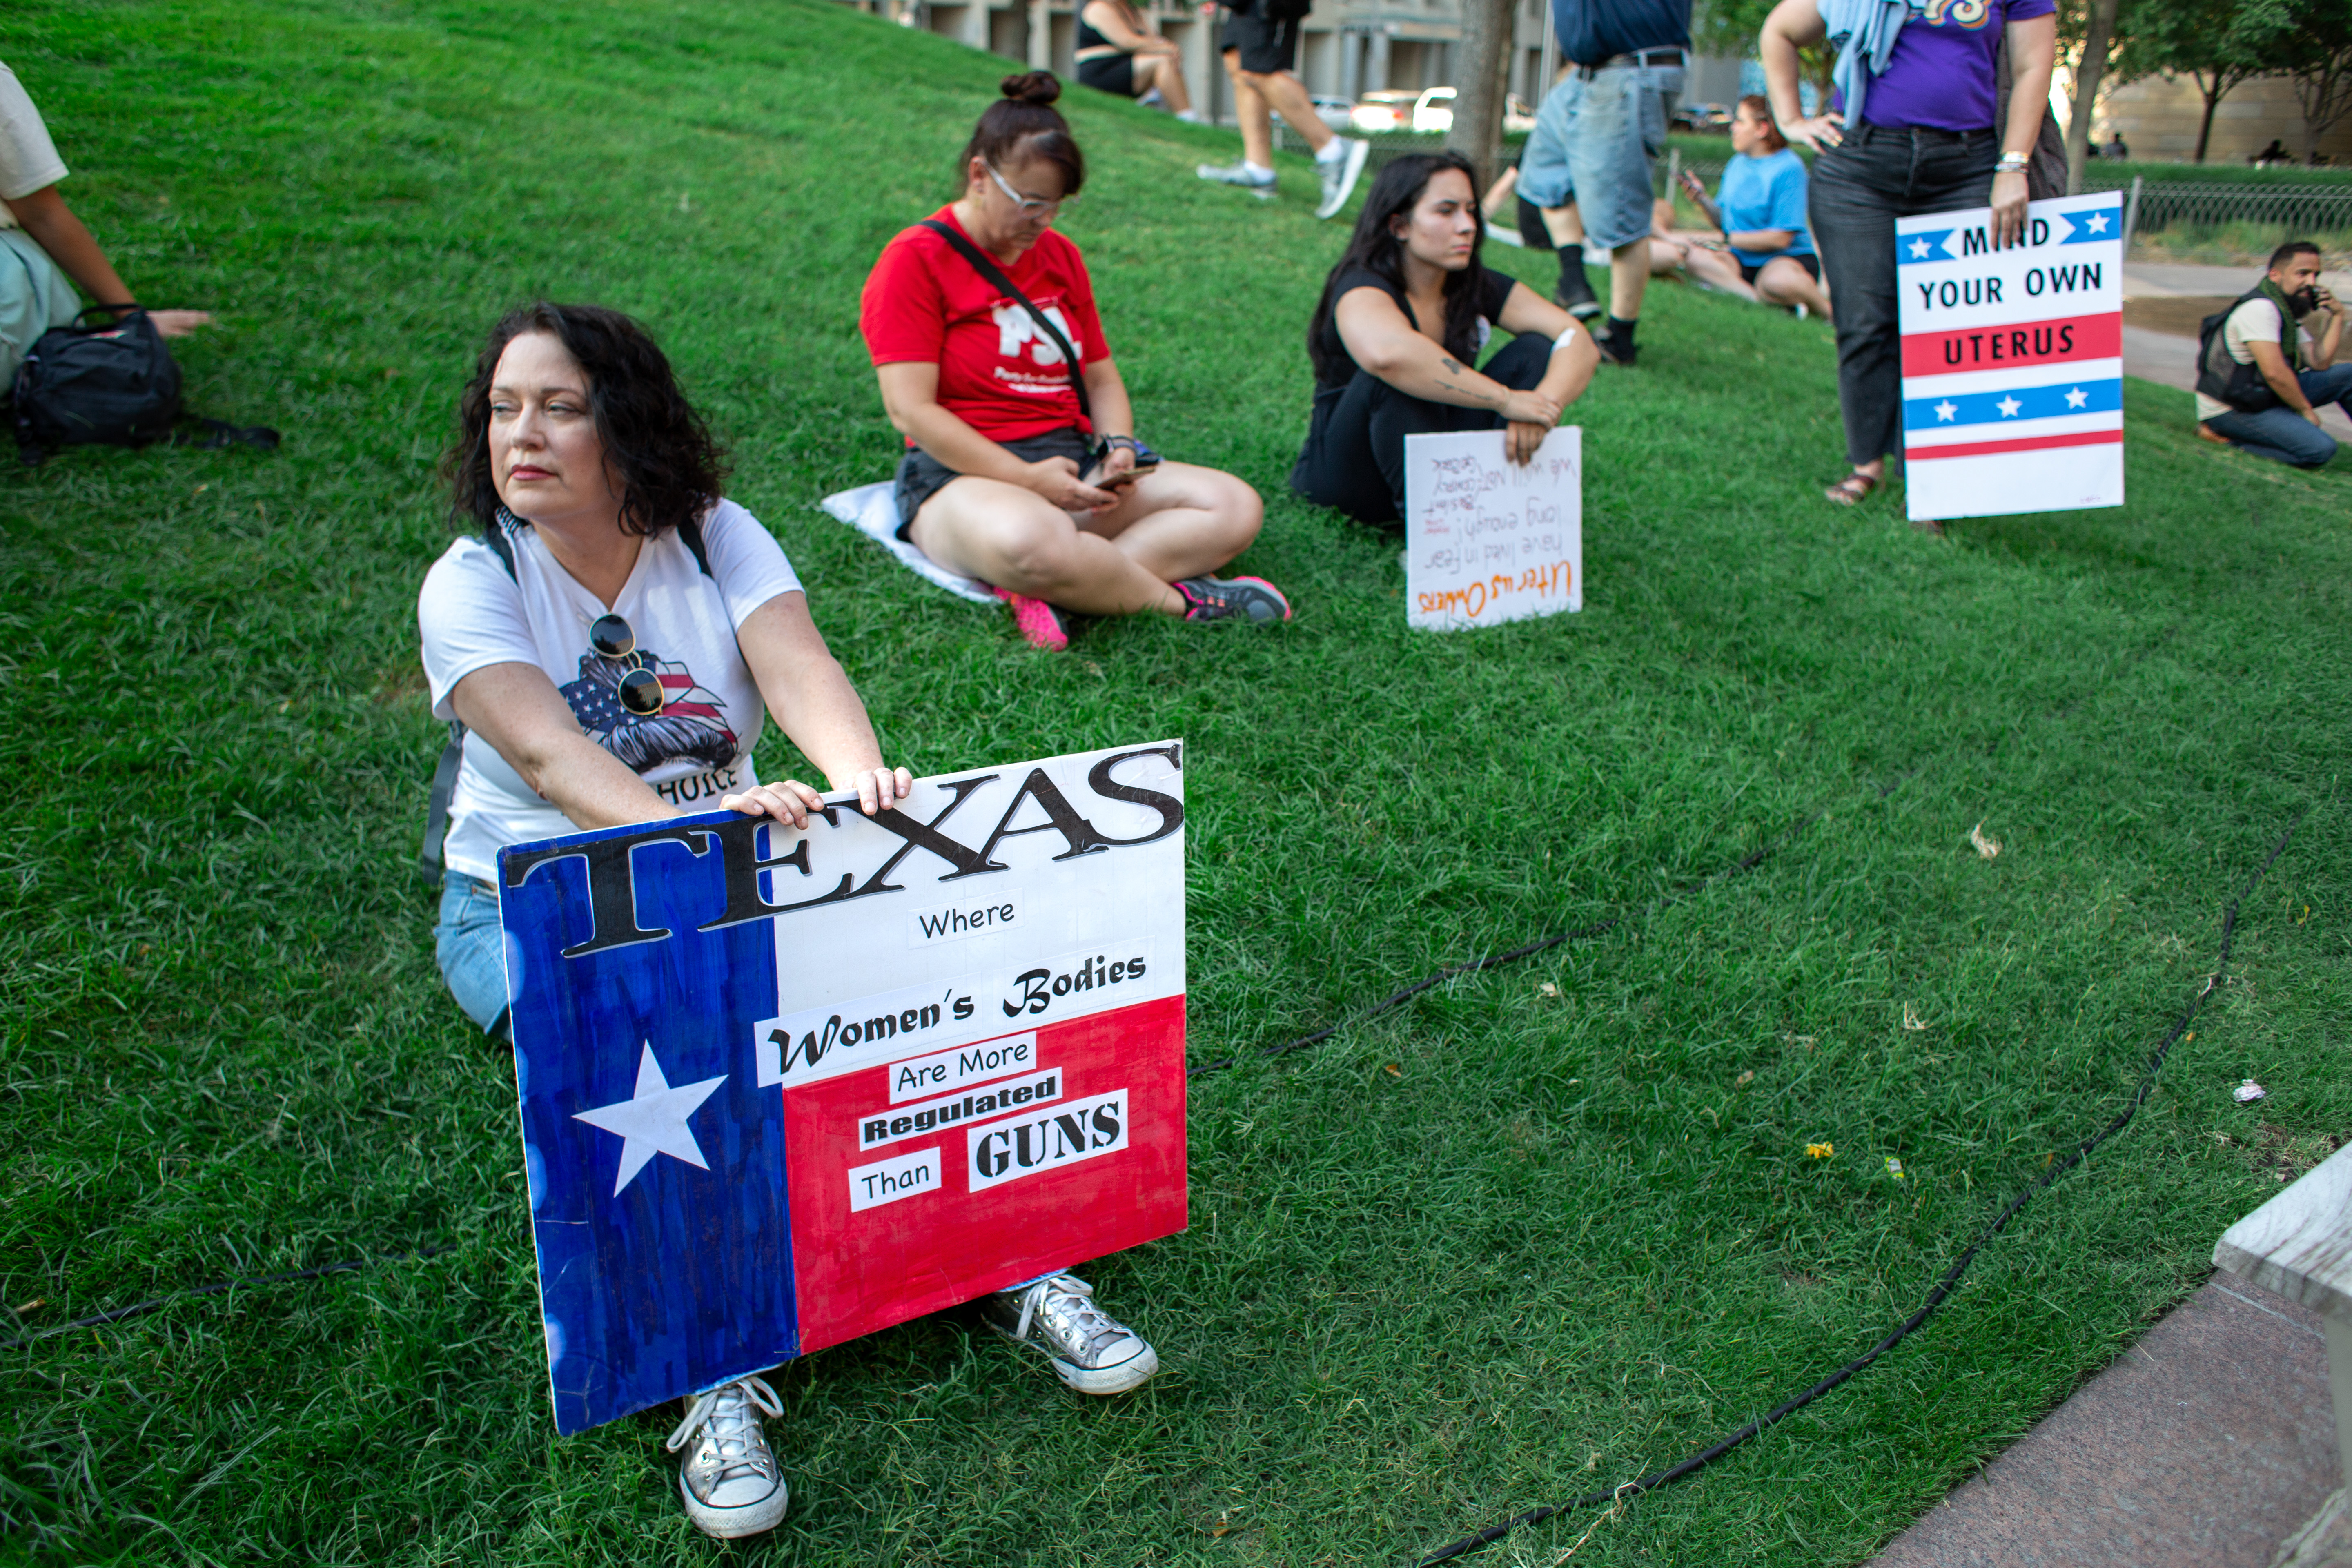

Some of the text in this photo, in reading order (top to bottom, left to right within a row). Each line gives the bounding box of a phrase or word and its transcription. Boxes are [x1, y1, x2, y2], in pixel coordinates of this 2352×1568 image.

[1963, 218, 2050, 256] MND
[1918, 263, 2103, 310] YOUR OWN
[1944, 325, 2075, 365] UTERUS
[505, 743, 1185, 959] TEXAS
[918, 902, 1015, 939] Where
[768, 955, 1147, 1076] Women's Bodies
[898, 1043, 1029, 1092] Are More
[864, 1075, 1056, 1144] Regulated
[860, 1100, 1120, 1199] Than GUNS
